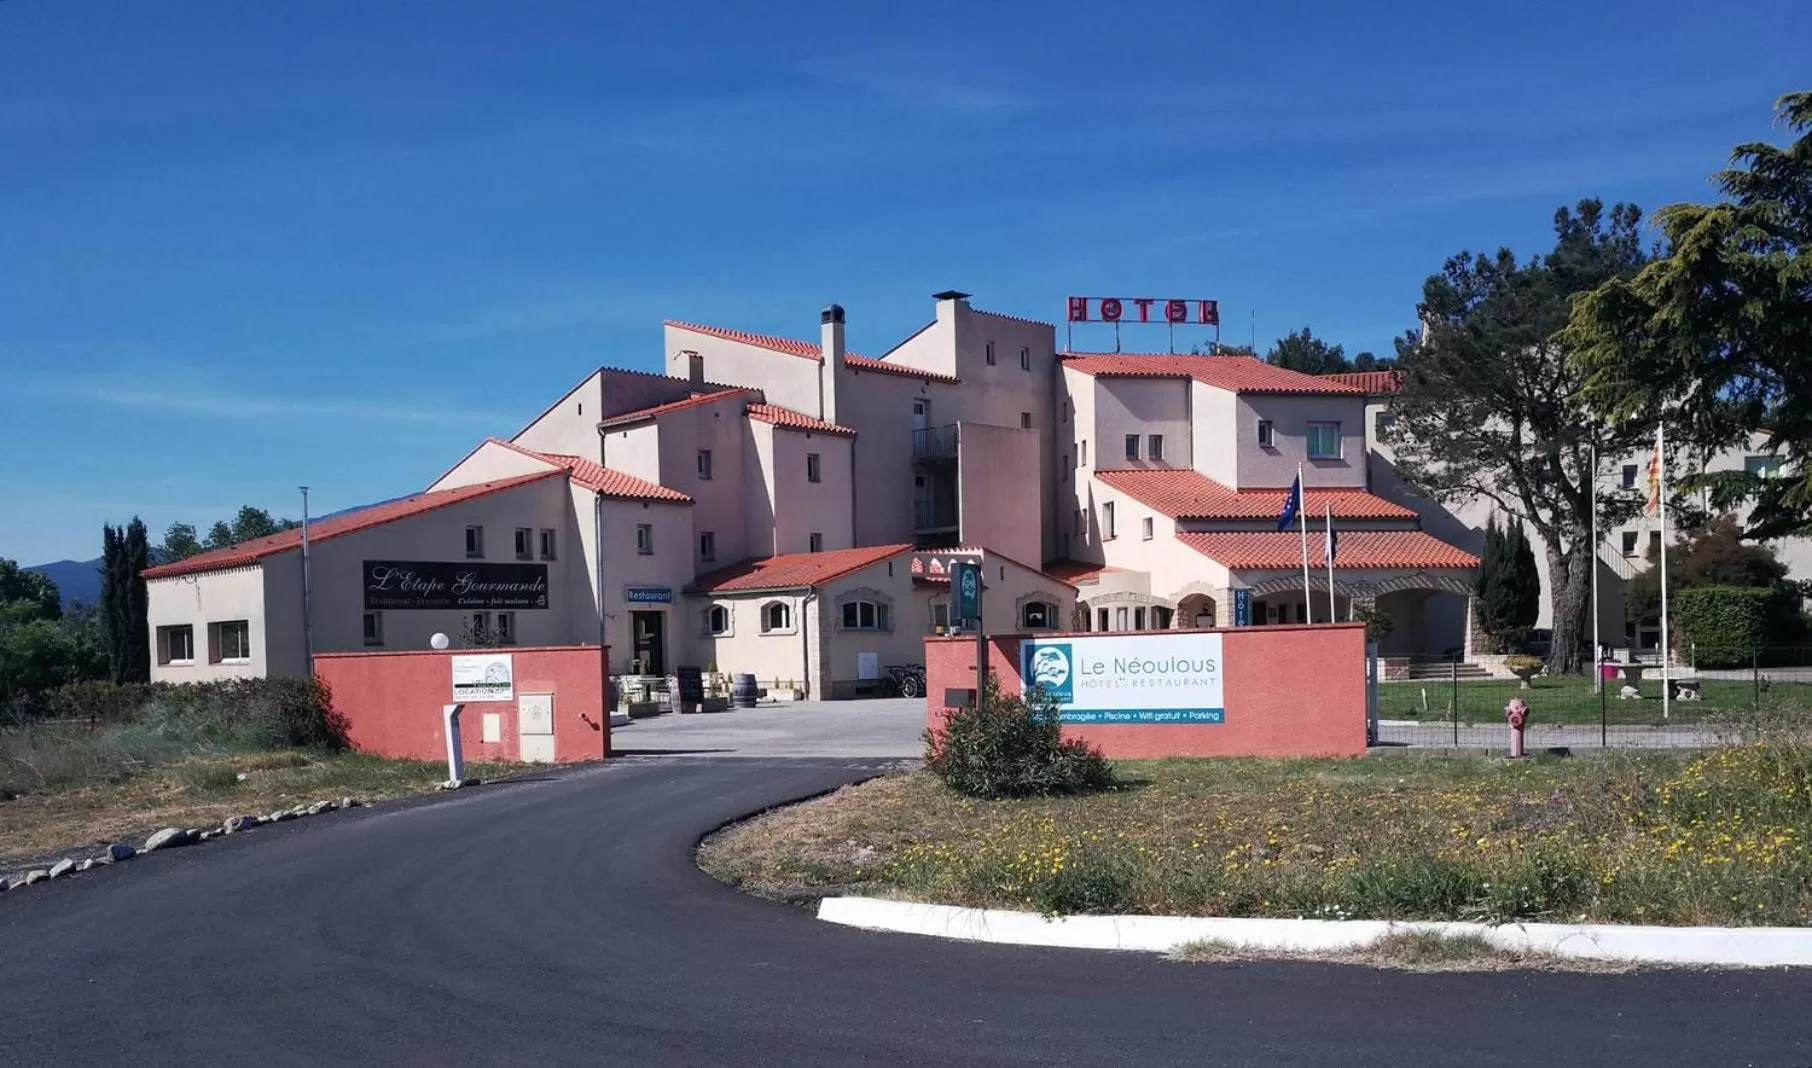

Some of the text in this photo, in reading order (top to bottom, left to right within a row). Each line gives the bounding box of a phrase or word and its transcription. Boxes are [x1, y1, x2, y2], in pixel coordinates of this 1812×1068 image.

[1068, 297, 1219, 325] HOTEL
[369, 566, 546, 597] L'Etape Gourmande
[628, 591, 671, 600] Restaurant
[1237, 591, 1245, 627] Hôte
[1081, 656, 1216, 675] Le Néoulous
[1132, 677, 1216, 688] RESTAURANT
[1104, 711, 1131, 720] Piscine
[1189, 710, 1220, 721] Parking
